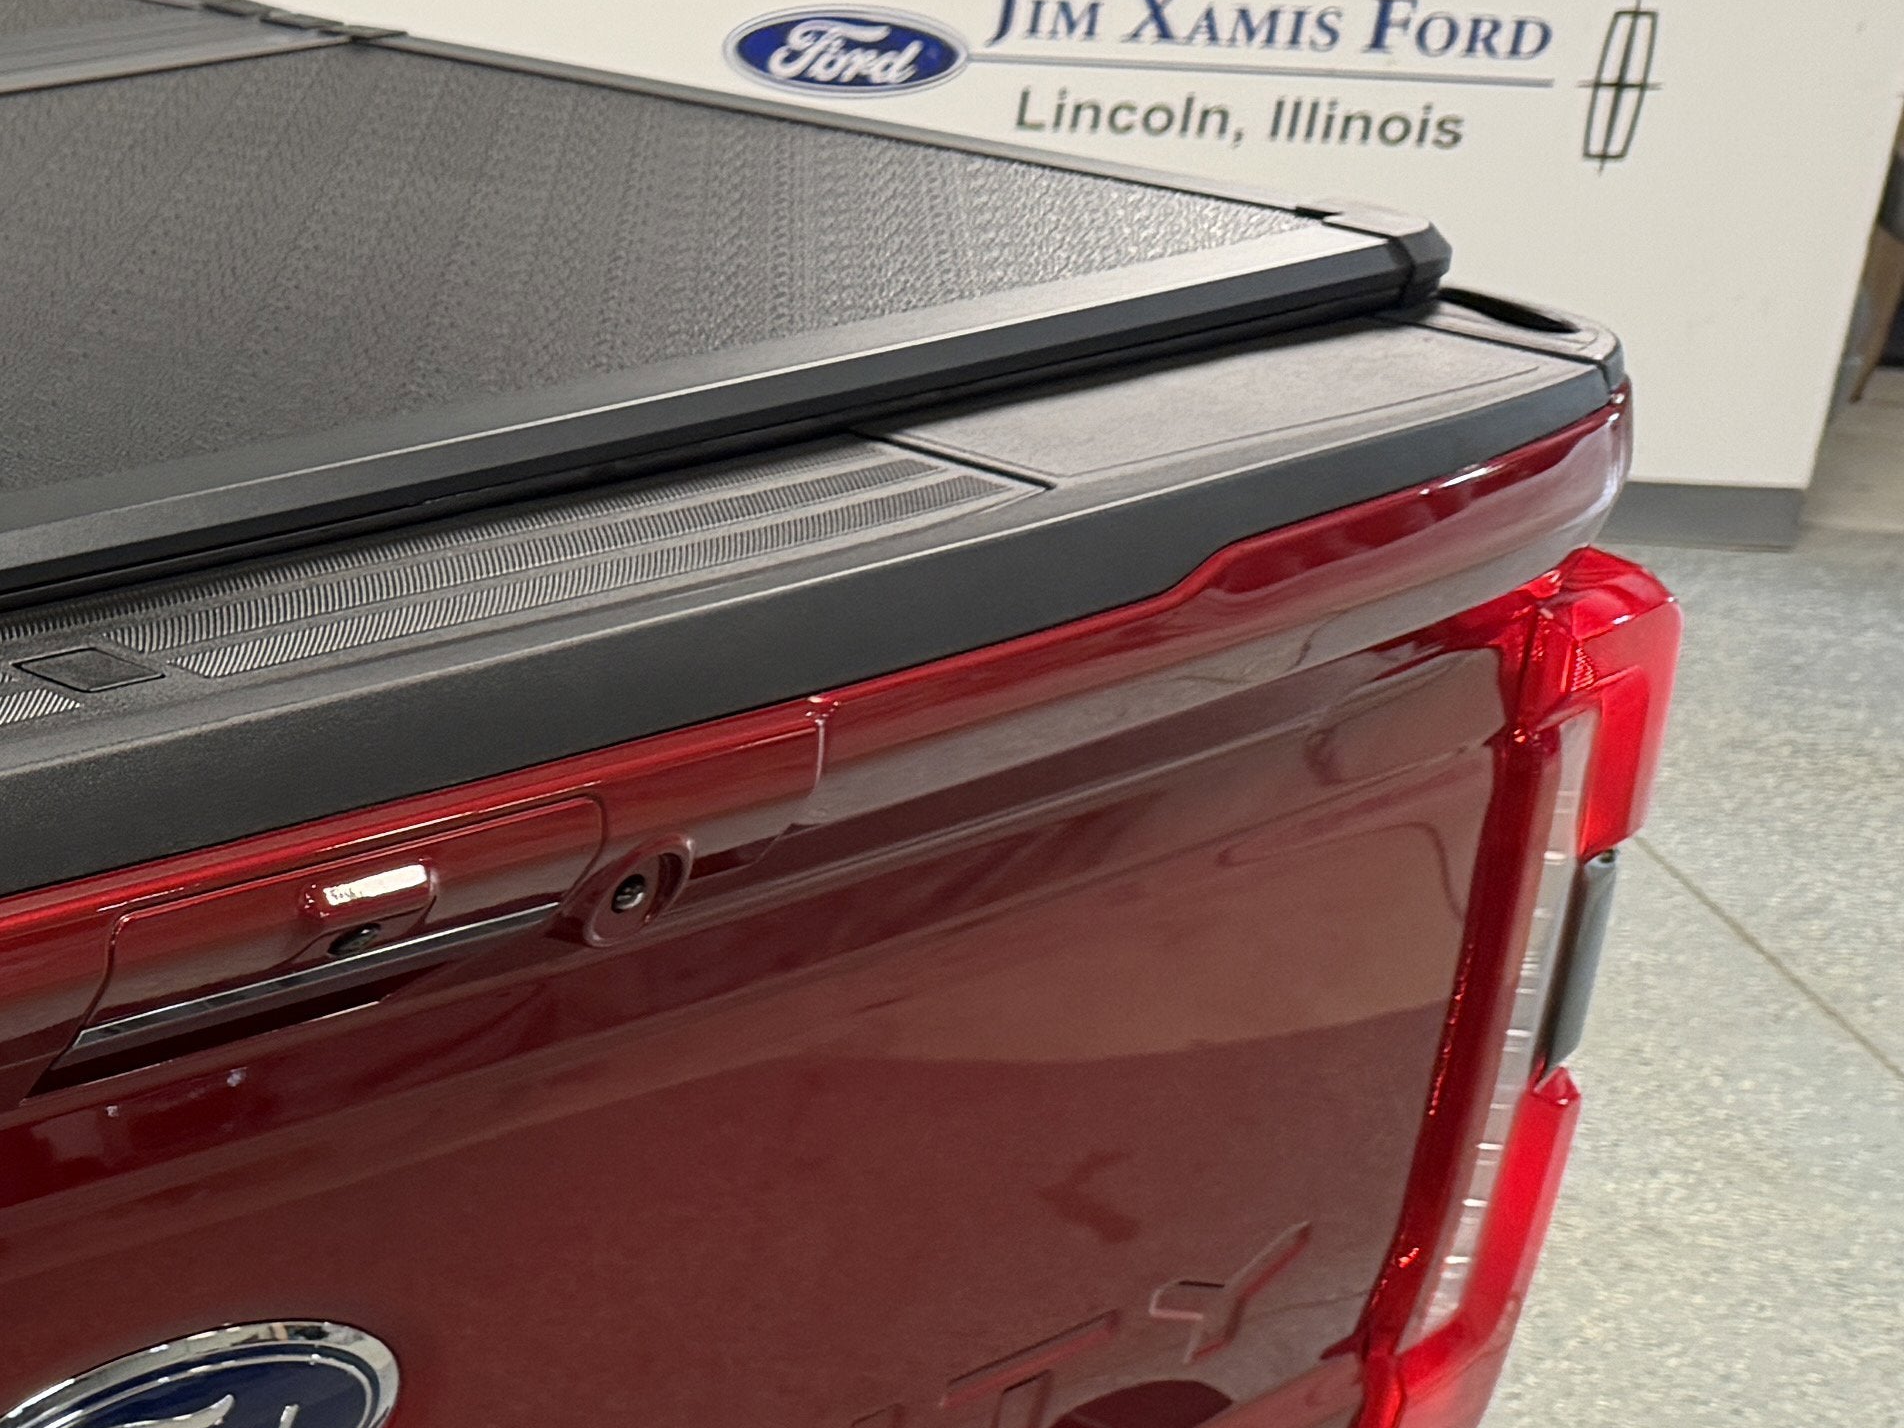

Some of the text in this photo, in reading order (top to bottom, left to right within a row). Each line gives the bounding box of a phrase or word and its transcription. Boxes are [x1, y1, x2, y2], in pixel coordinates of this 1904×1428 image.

[769, 18, 924, 85] Ford
[1016, 87, 1463, 149] Lincoln, Illinois
